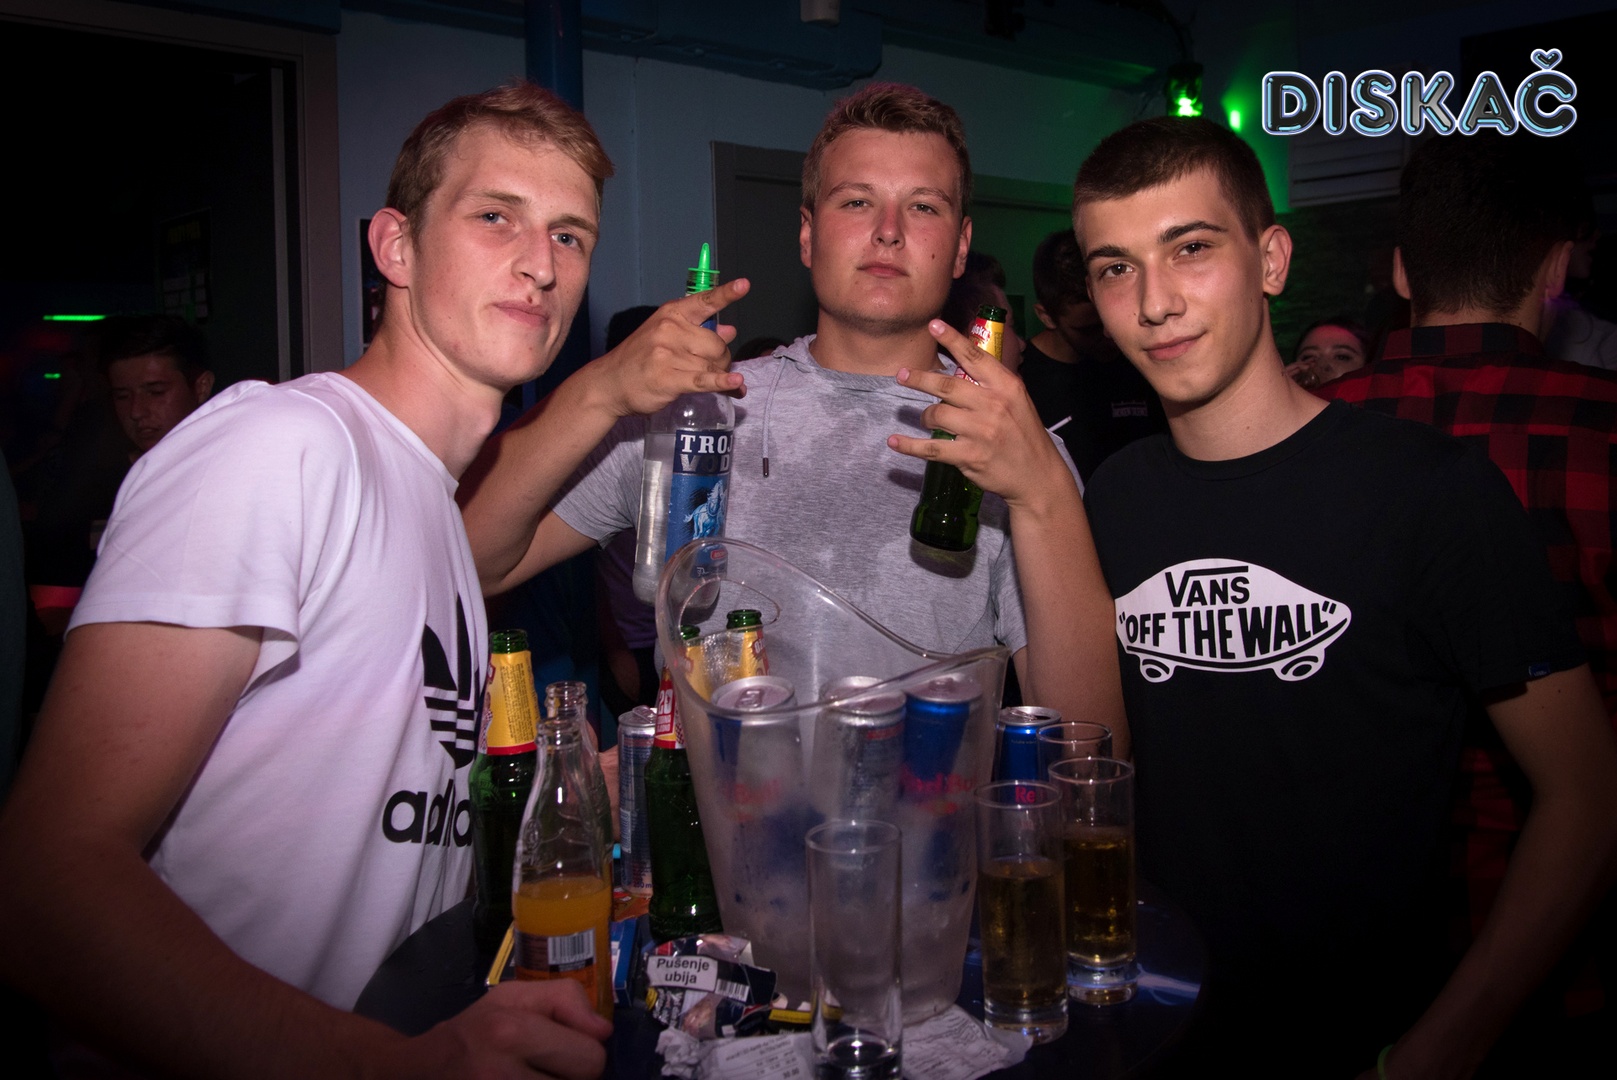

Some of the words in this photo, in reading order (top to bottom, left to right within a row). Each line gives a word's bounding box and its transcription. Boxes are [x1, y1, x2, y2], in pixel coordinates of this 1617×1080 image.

[680, 434, 733, 454] TROJ
[680, 453, 730, 472] VOD
[1165, 565, 1250, 608] VANS
[1172, 608, 1236, 659] THE
[1014, 786, 1036, 803] Re
[656, 958, 710, 973] Pušenje
[664, 971, 697, 986] ubija
